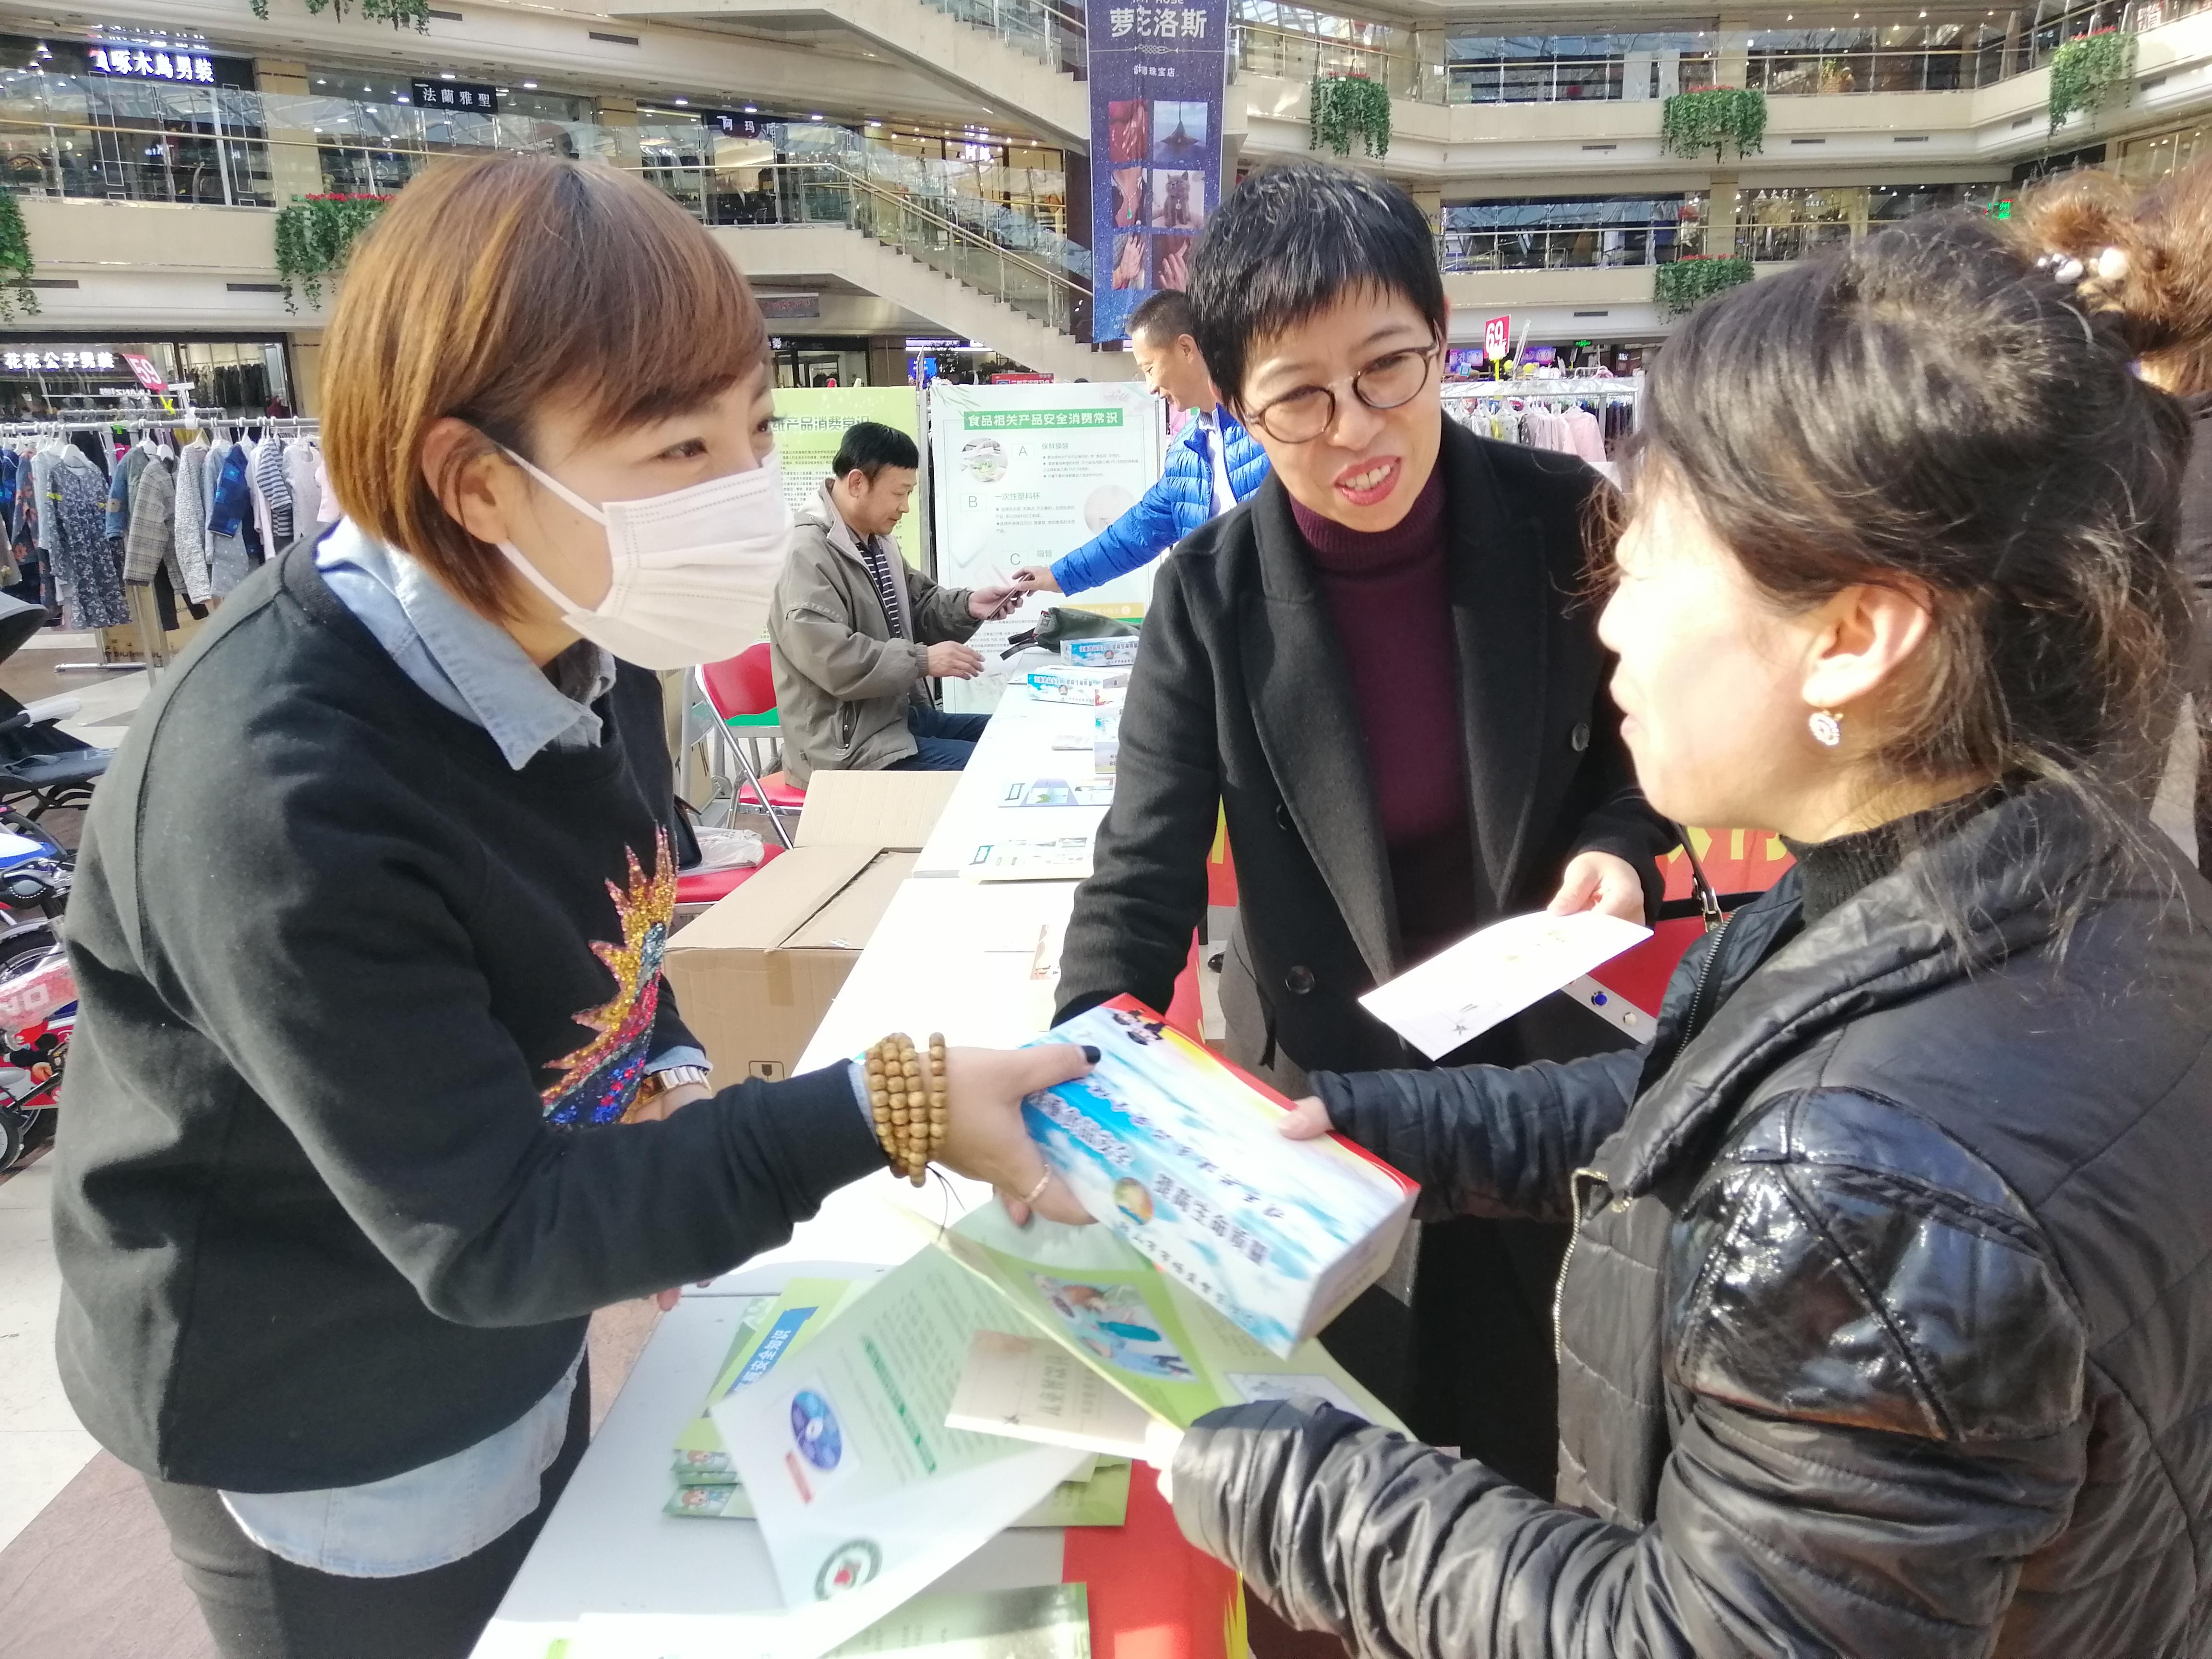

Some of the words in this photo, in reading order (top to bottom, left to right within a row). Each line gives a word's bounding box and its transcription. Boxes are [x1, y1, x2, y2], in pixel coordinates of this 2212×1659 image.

[1486, 320, 1503, 352] 69
[129, 358, 163, 385] 59
[968, 411, 1118, 427] 食品相关产品安全消费常识
[1018, 445, 1028, 457] A
[968, 495, 978, 508] B
[995, 492, 1041, 500] 一次性塑料杯
[1010, 553, 1021, 565] C
[1037, 550, 1053, 558] 吸管
